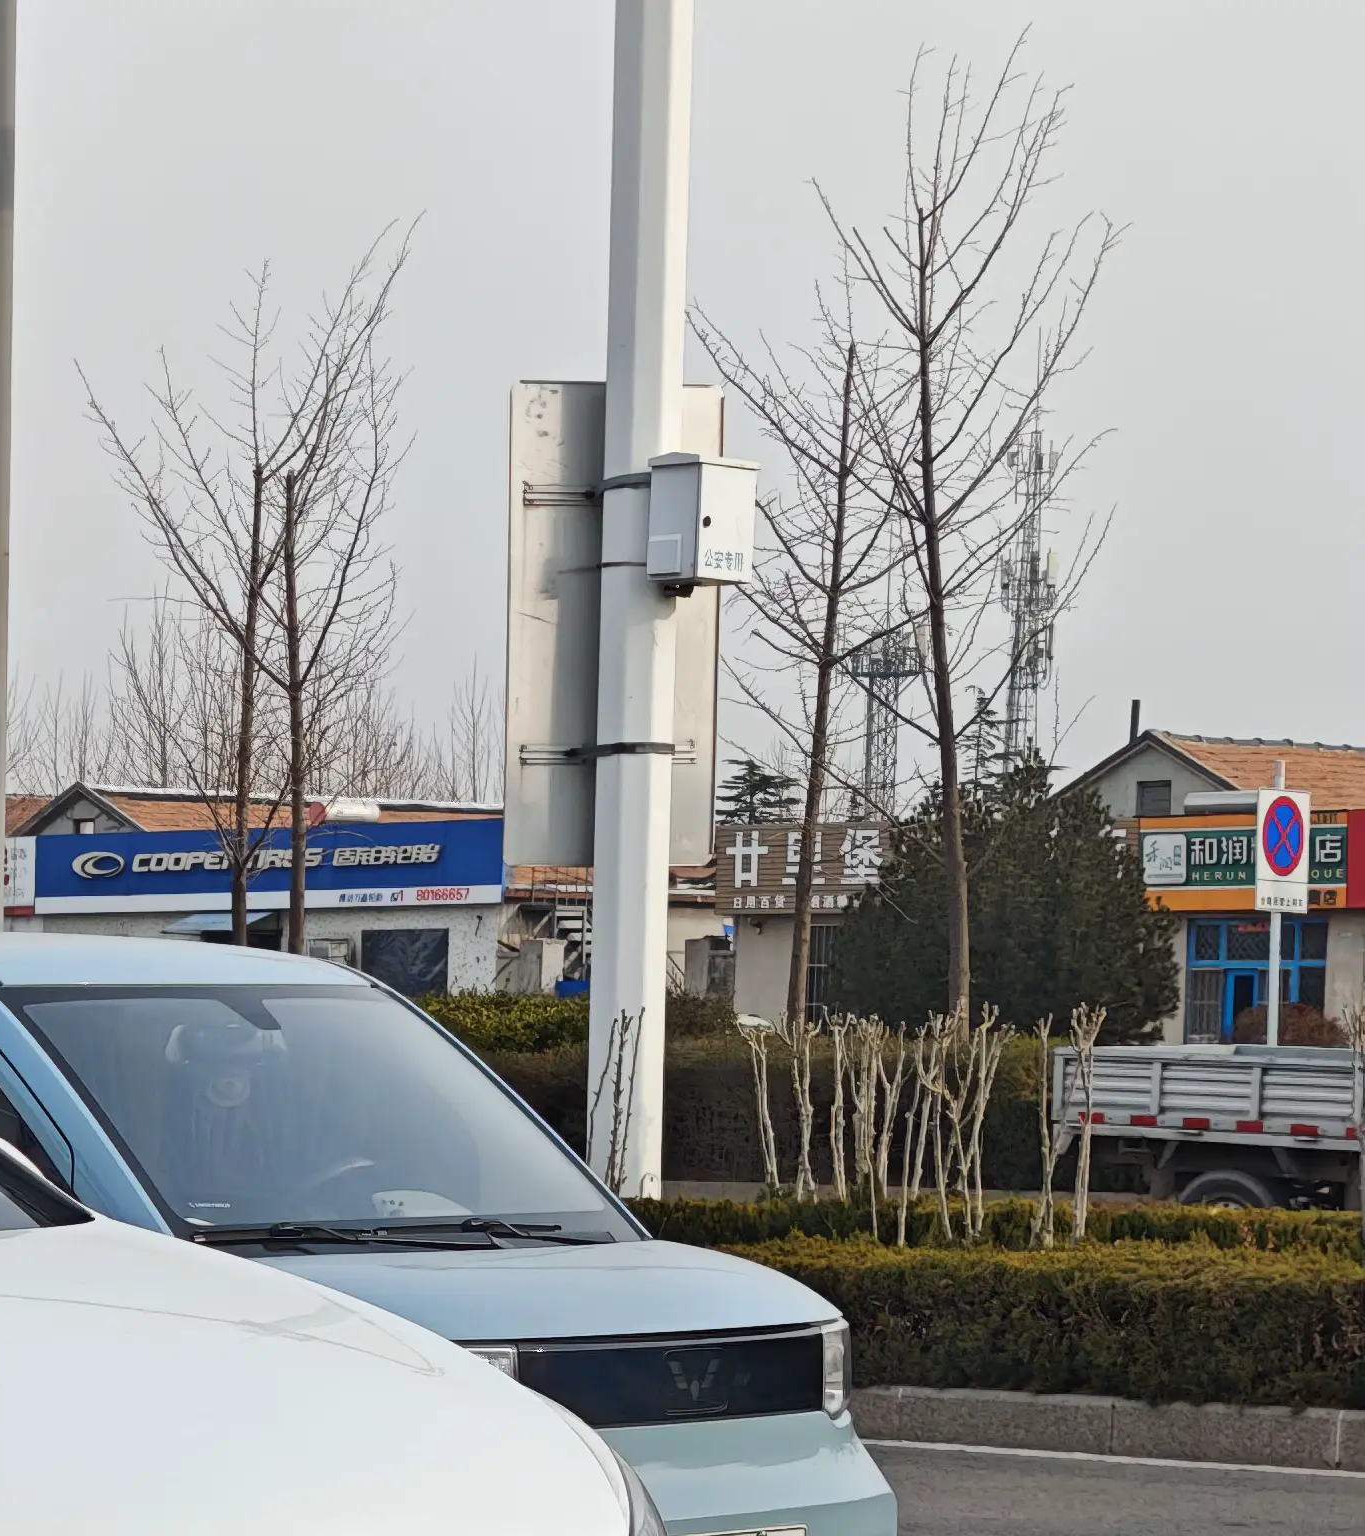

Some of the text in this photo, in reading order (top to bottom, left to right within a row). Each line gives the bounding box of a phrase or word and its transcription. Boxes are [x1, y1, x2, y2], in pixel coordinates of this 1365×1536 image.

[704, 549, 744, 572] 公安专用
[132, 851, 230, 873] COOPE
[726, 829, 884, 888] 廿里堡
[1192, 871, 1247, 881] HERUN
[1310, 868, 1345, 879] QUE
[733, 894, 786, 909] 日用百货
